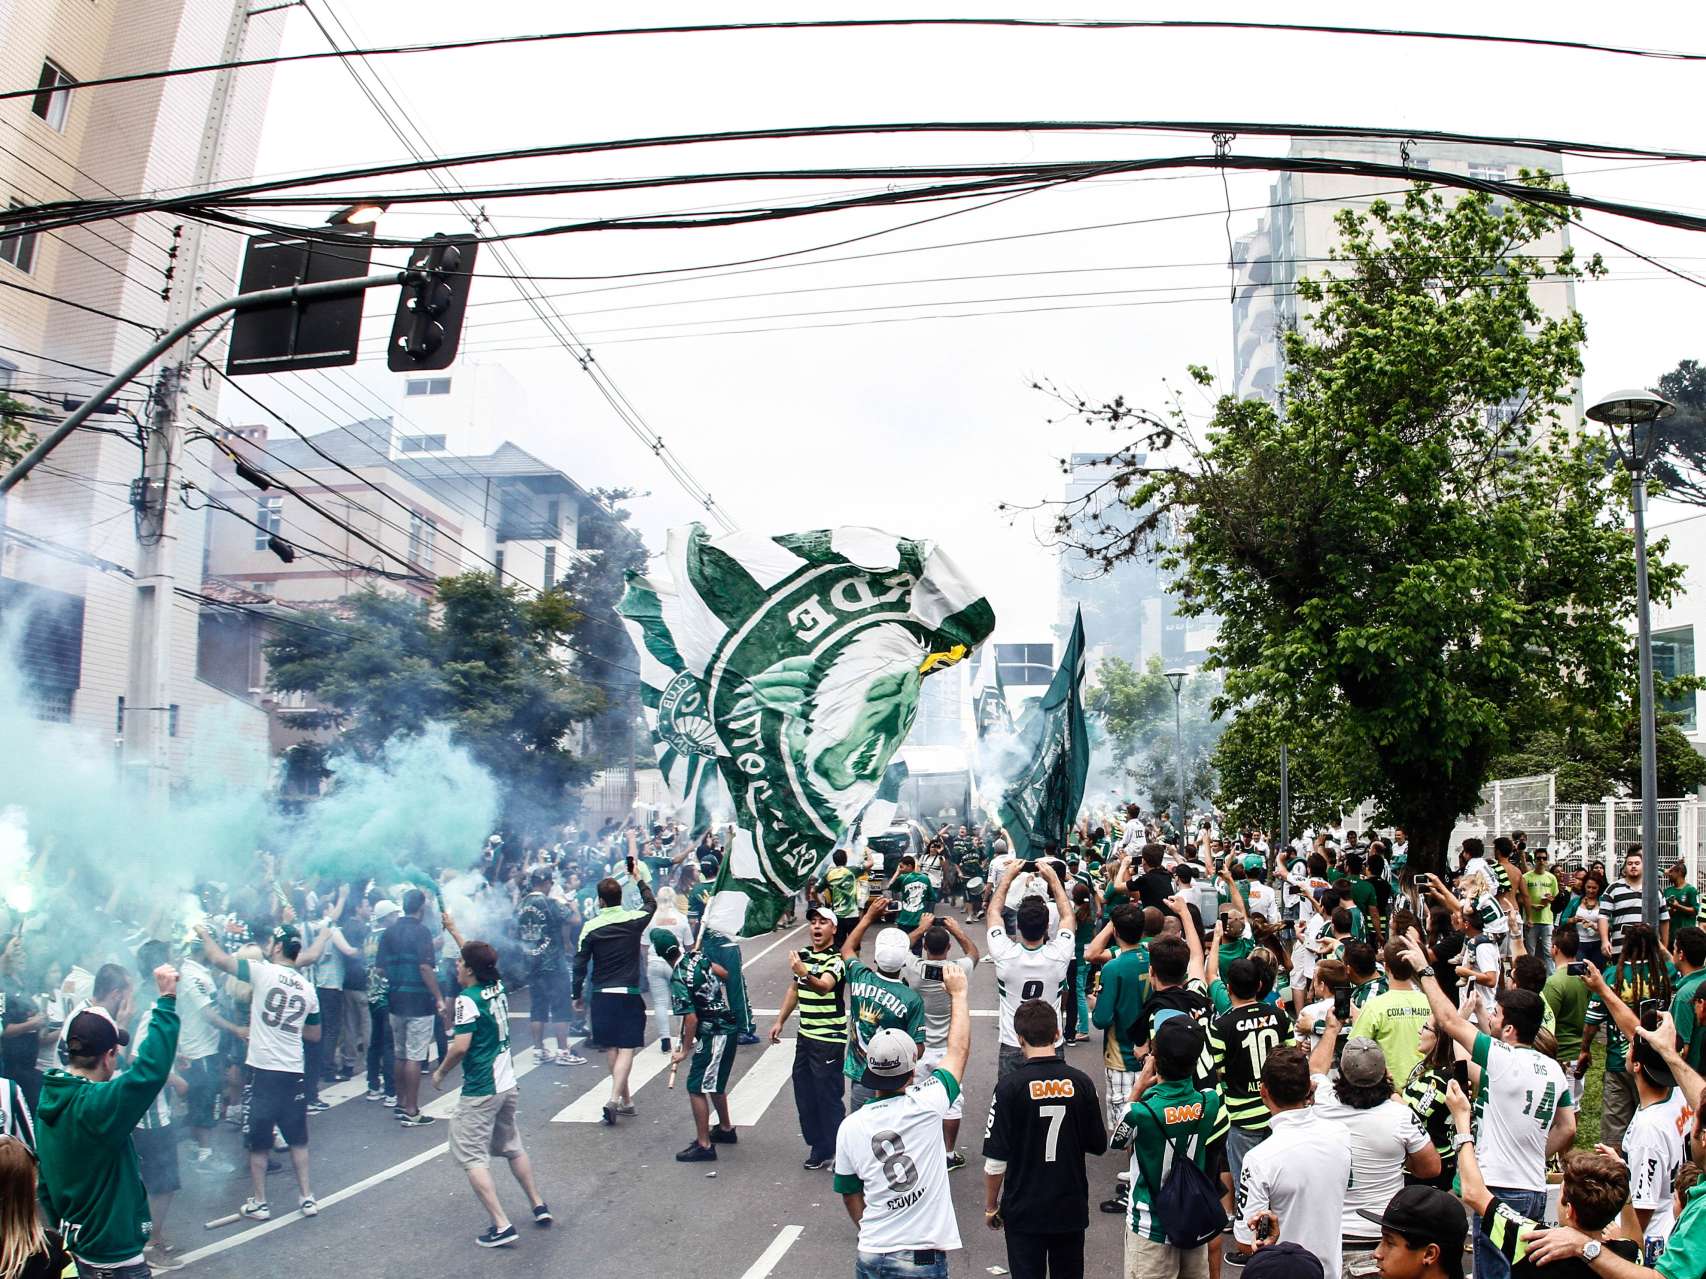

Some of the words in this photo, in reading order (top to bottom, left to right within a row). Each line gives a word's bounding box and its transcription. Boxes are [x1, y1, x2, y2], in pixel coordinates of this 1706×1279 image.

[262, 987, 306, 1034] 92
[1387, 1008, 1405, 1017] COXA
[1411, 1007, 1430, 1017] MAIOR
[1236, 1014, 1278, 1032] CAIXA
[1029, 1079, 1074, 1099] BMG
[1247, 1081, 1261, 1092] ALE
[1164, 1103, 1204, 1125] BMG
[1039, 1105, 1066, 1162] 7
[871, 1129, 919, 1193] 8
